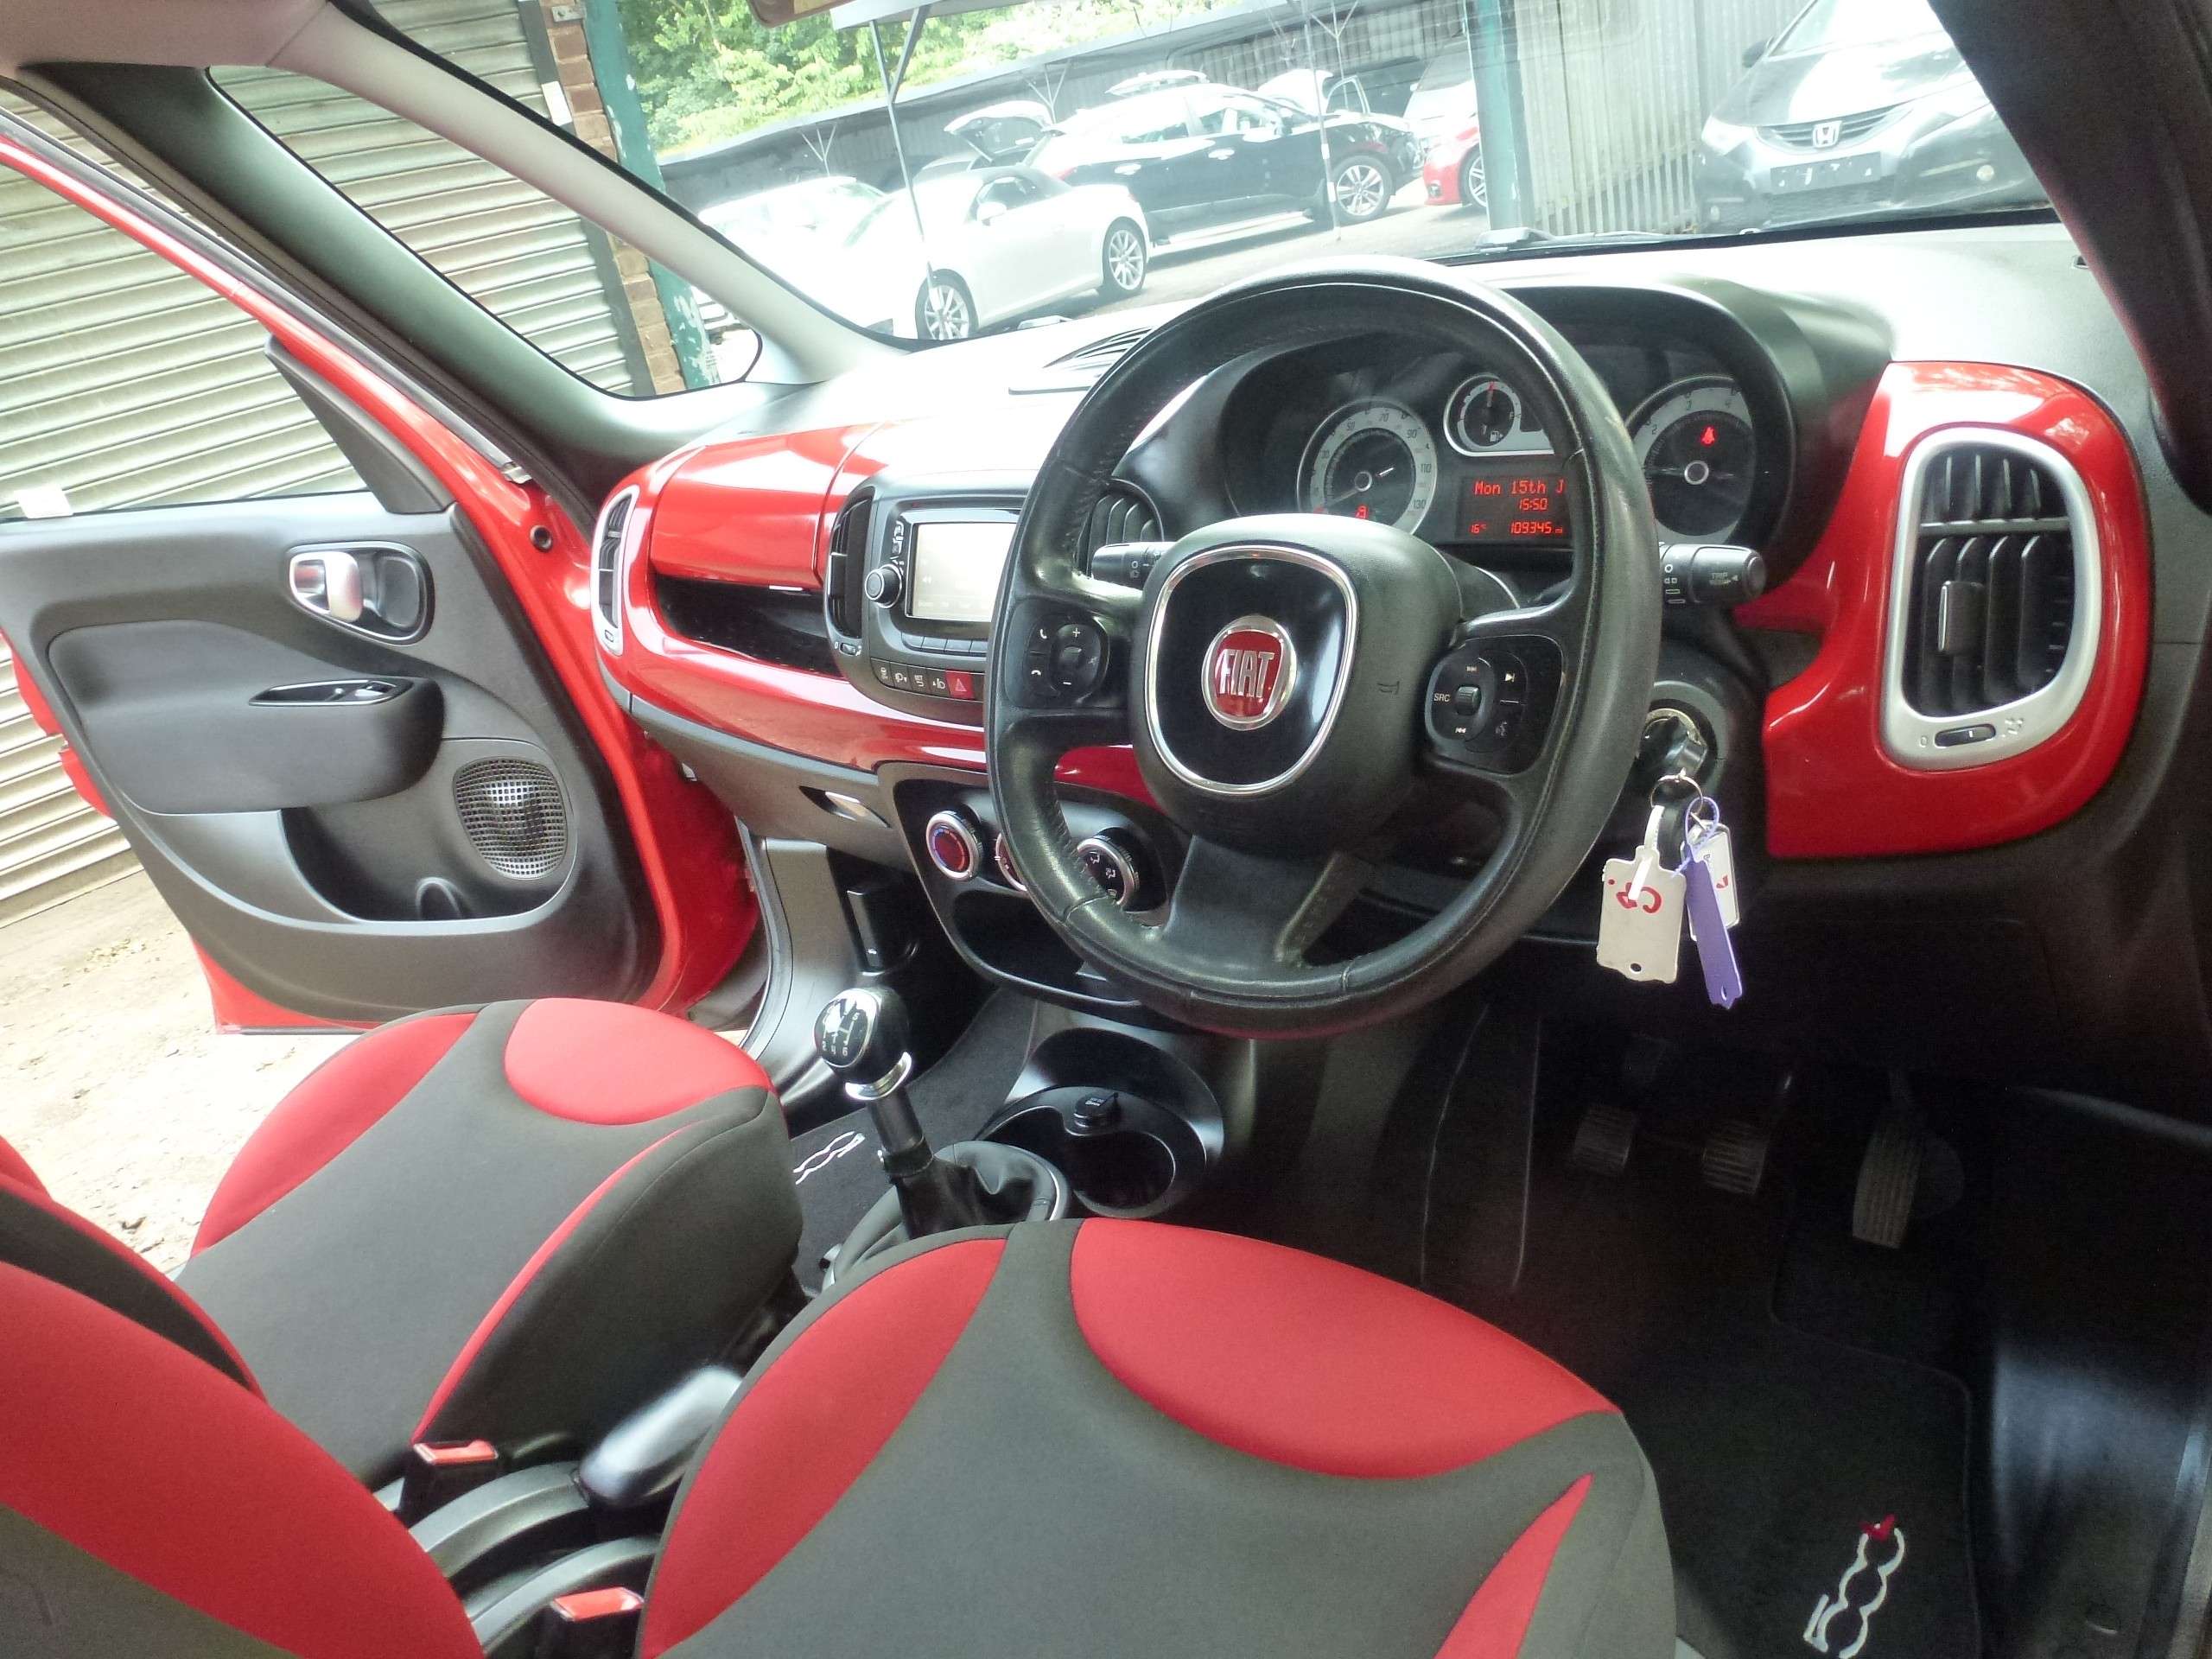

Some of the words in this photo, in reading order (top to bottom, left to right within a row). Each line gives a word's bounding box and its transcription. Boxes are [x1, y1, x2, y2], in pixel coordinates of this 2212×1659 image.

[1474, 480, 1501, 494] Mon
[1510, 480, 1546, 494] 15th
[1510, 521, 1553, 534] 109345
[1218, 648, 1275, 698] FIAT
[1433, 692, 1451, 702] SRC
